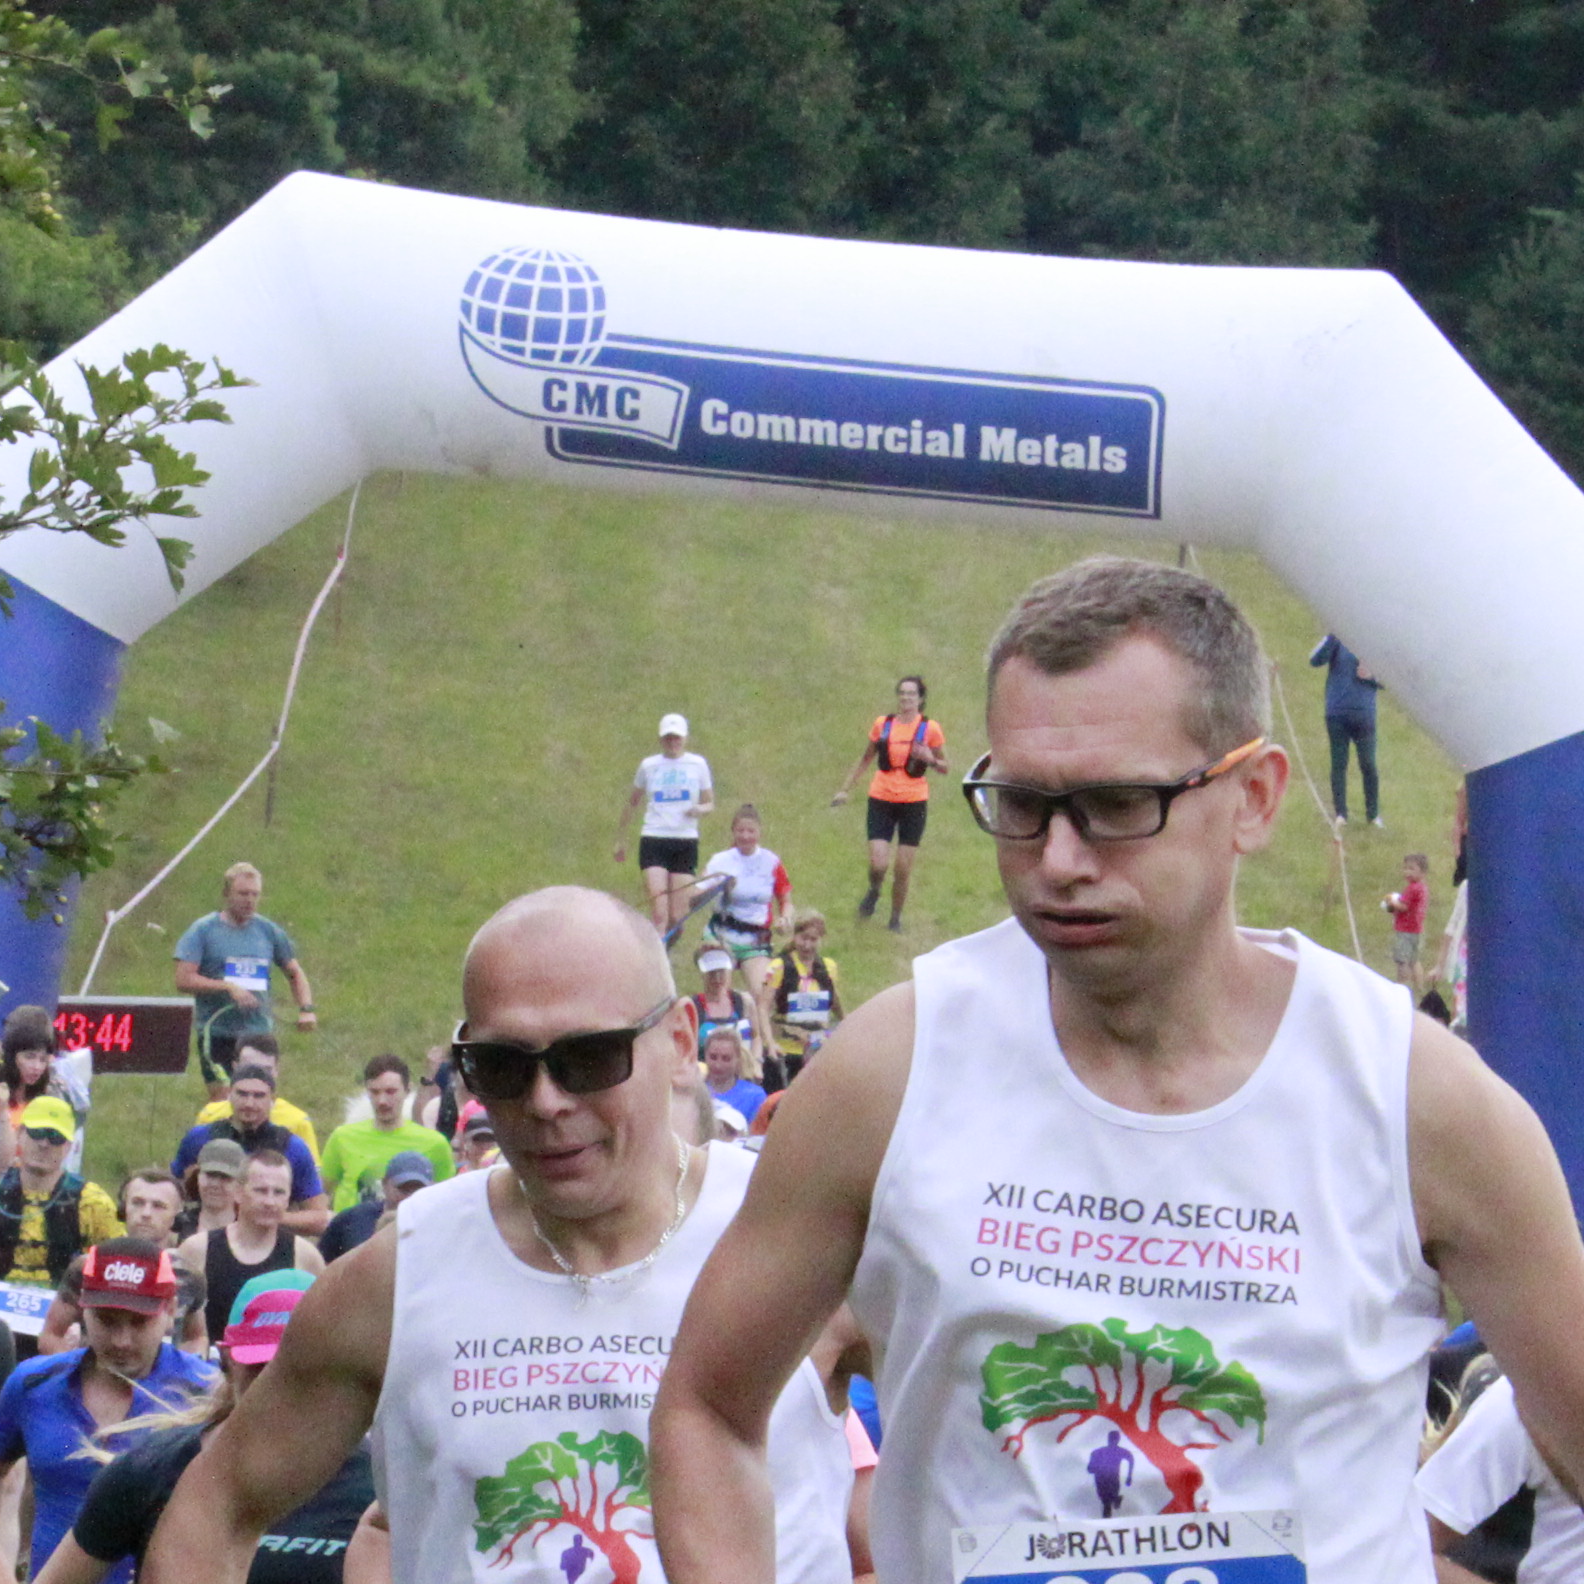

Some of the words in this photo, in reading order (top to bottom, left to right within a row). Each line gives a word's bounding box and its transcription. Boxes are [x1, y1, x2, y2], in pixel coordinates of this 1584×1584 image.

[540, 377, 642, 423] CMC
[699, 397, 966, 460] Commercial
[978, 424, 1128, 475] Metals
[982, 1181, 1025, 1208] XII
[1032, 1189, 1144, 1223] CARBO
[1152, 1202, 1300, 1236] ASECURA
[977, 1217, 1062, 1255] BIEG
[1070, 1231, 1301, 1274] PSZCZYŃSKI
[970, 1256, 991, 1277] O
[998, 1260, 1111, 1294] PUCHAR
[1119, 1275, 1298, 1306] BURMISTRZA
[454, 1340, 486, 1360] XII
[493, 1336, 584, 1357] CARBO
[453, 1366, 518, 1392] BIEG
[451, 1401, 467, 1418] O
[472, 1394, 562, 1416] PUCHAR
[567, 1393, 656, 1412] BURMIS
